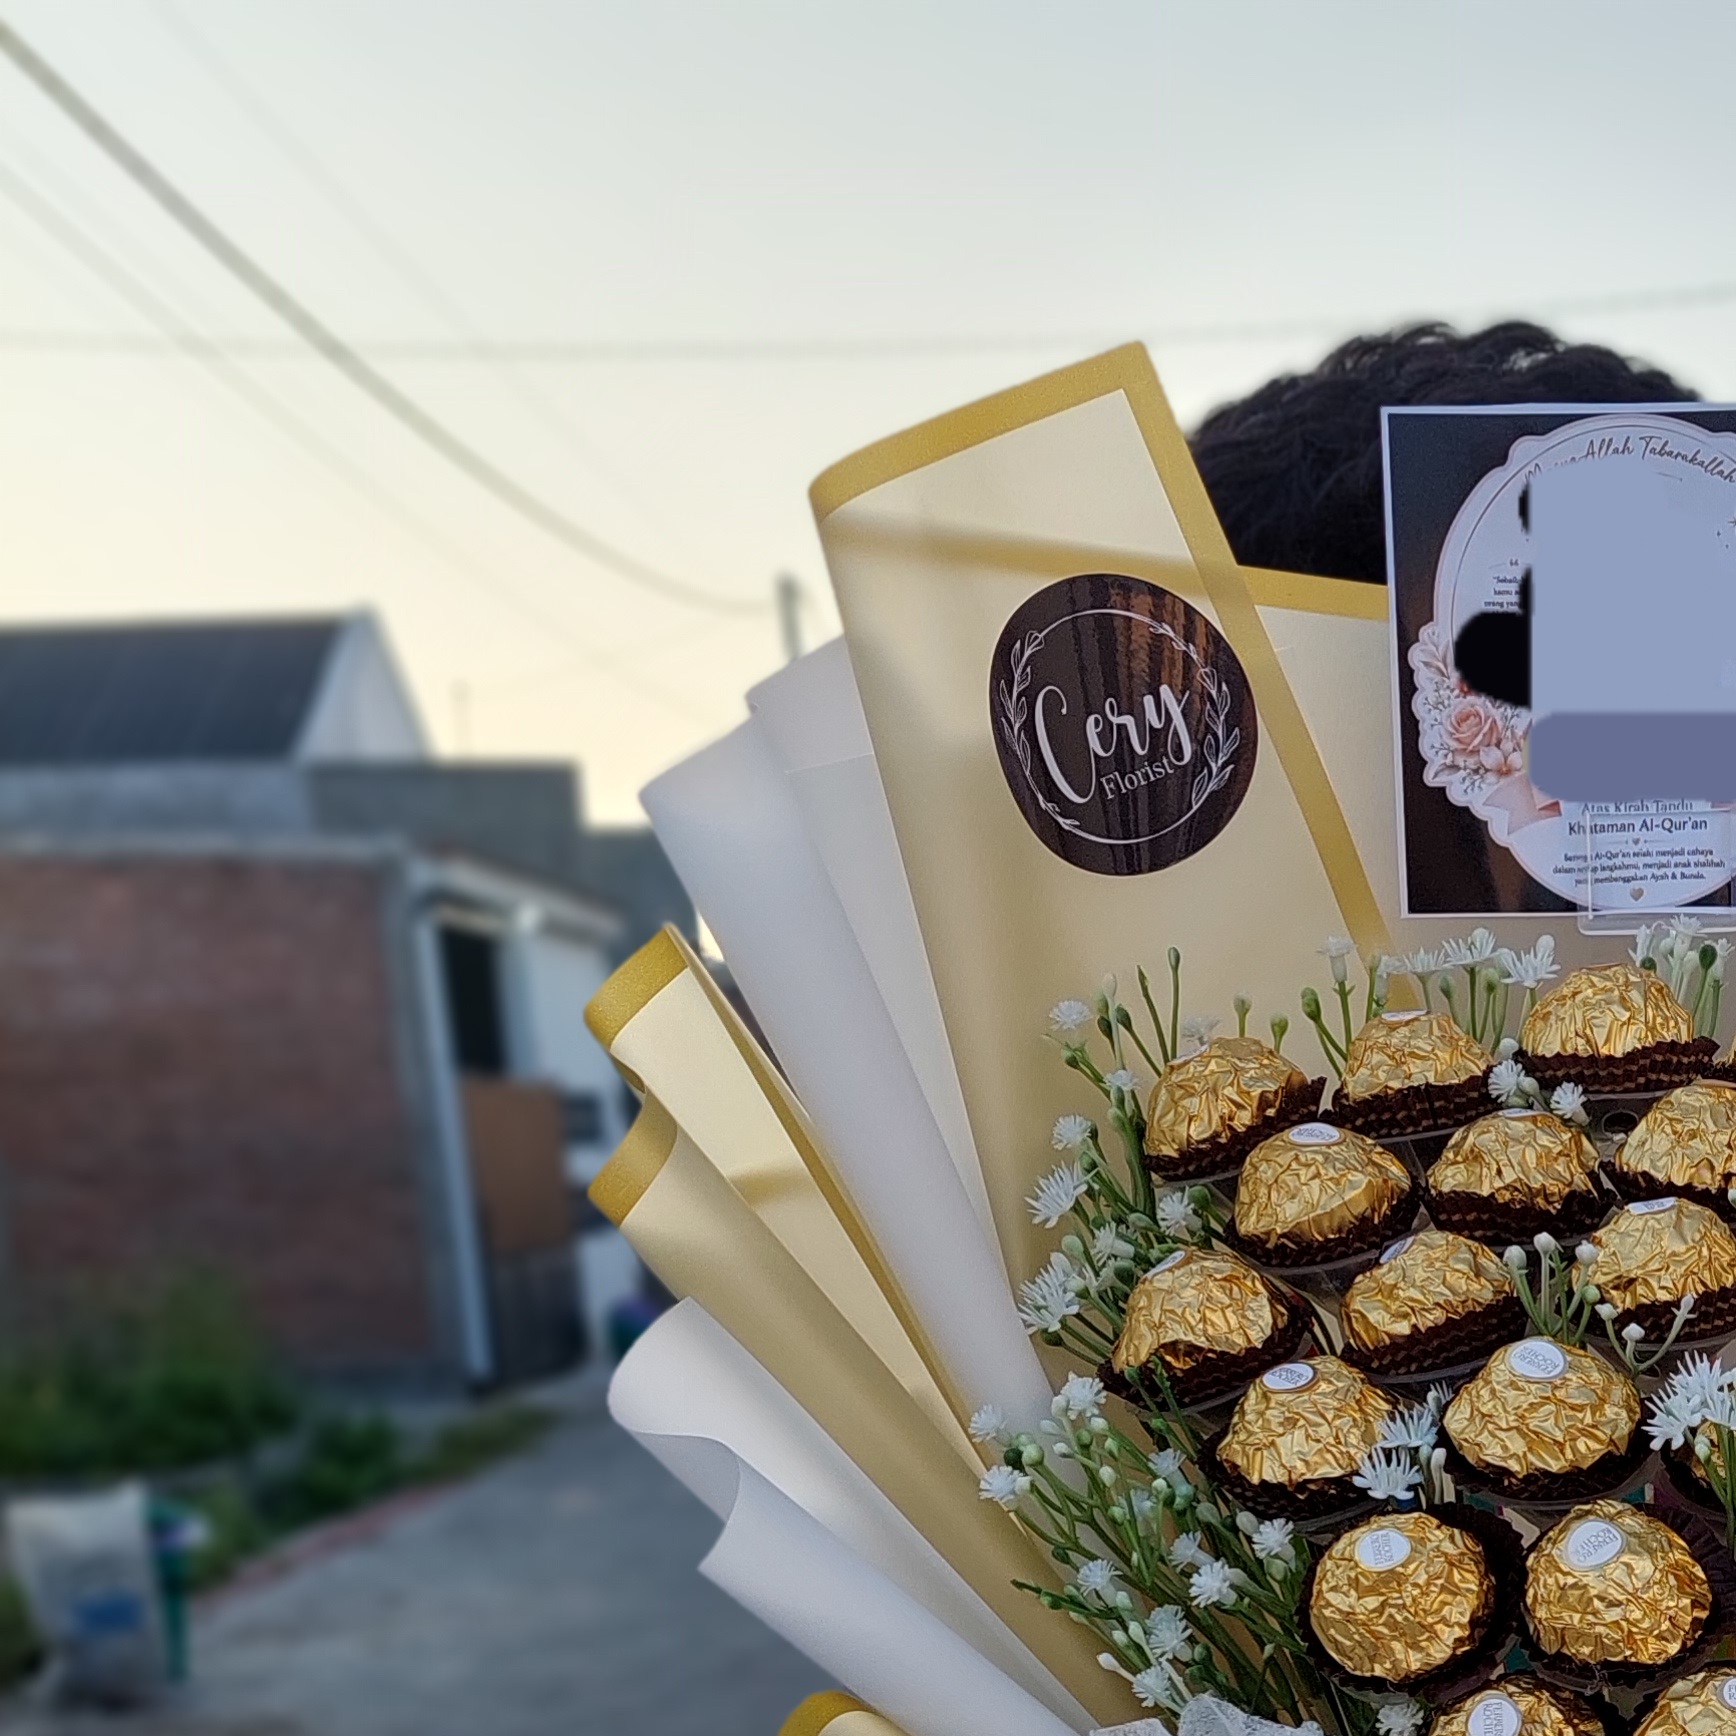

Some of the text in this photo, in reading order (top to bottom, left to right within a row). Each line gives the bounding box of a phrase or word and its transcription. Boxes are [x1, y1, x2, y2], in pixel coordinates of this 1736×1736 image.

[1639, 435, 1736, 483] Tabarakallah
[1035, 684, 1192, 803] Cery
[1100, 756, 1174, 799] Florist
[1639, 816, 1708, 834] Al-Qur'an
